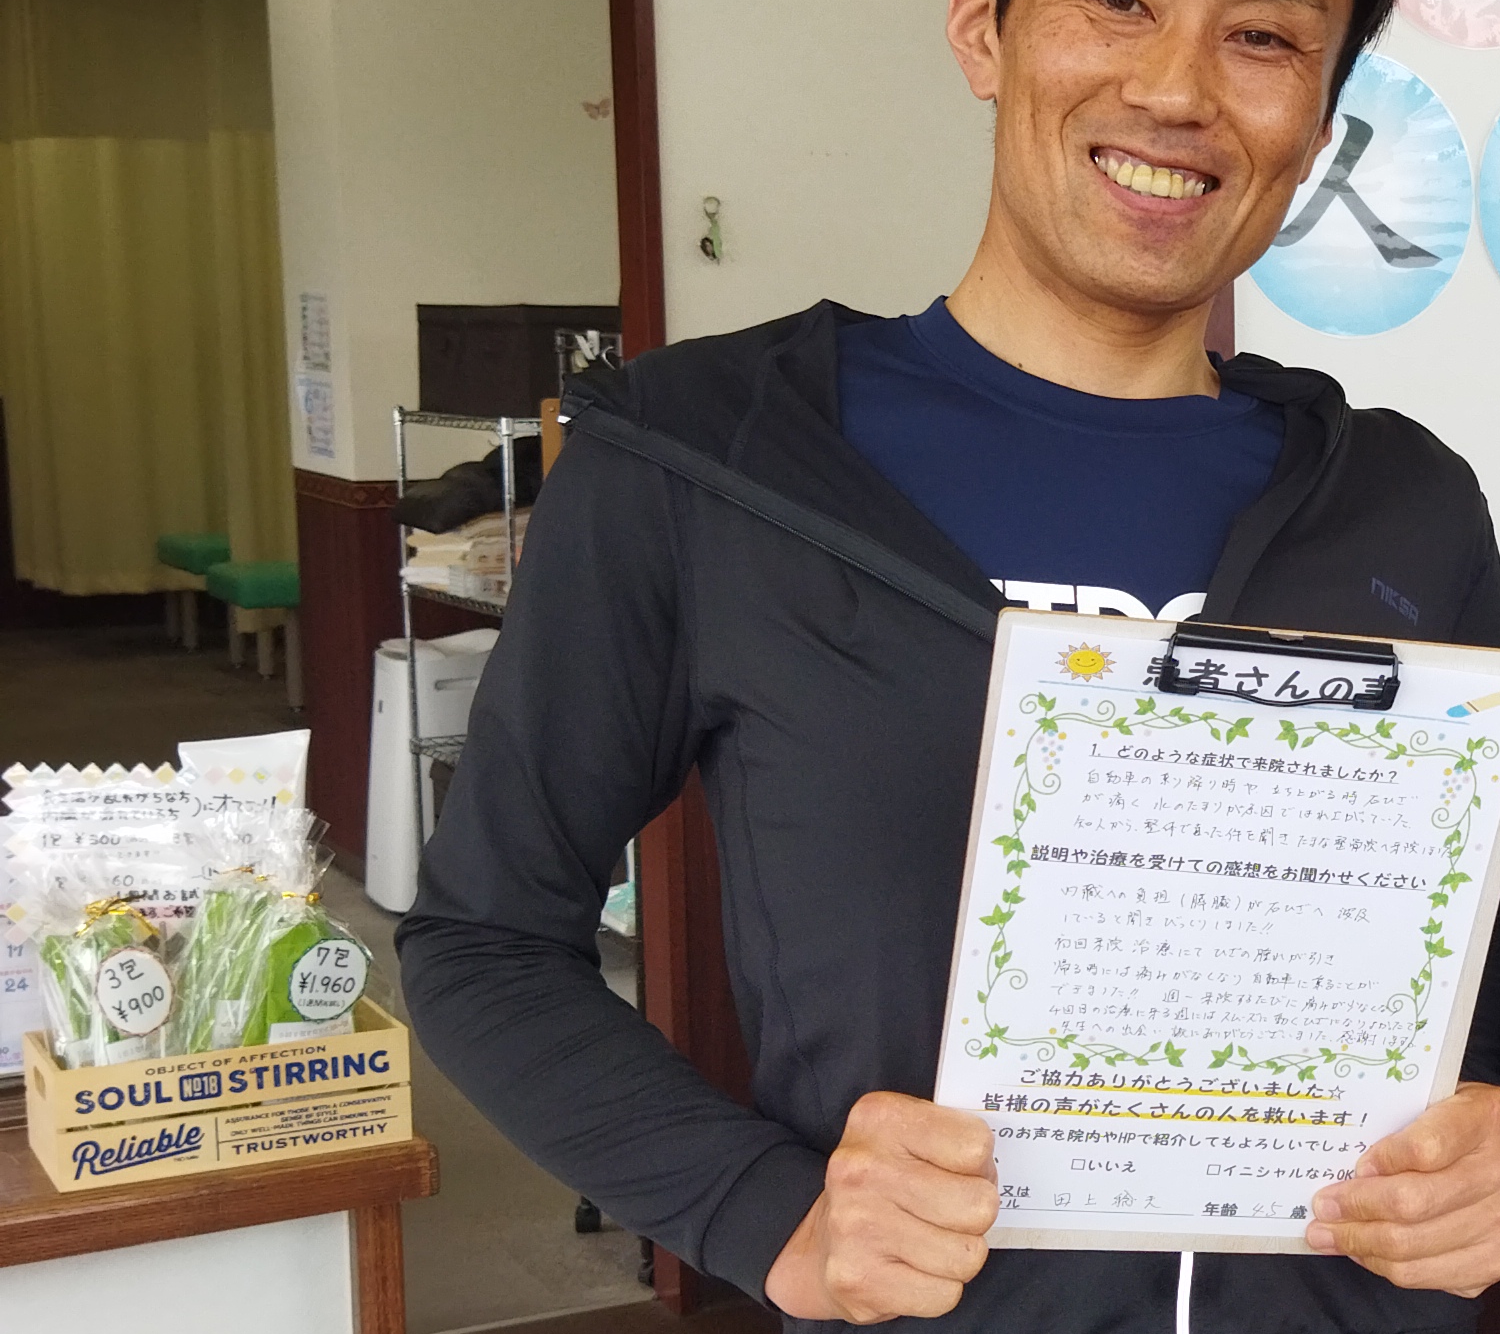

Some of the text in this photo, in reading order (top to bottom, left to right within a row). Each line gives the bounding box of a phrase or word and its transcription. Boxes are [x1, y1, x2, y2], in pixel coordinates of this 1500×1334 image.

[1030, 843, 1428, 889] 説明や治療を受けての感想をお聞かせください
[4, 978, 29, 993] 24
[111, 985, 165, 1023] ¥900
[145, 1044, 327, 1076] OBJECT OF AFFECTION
[74, 1080, 173, 1115] SOUL
[228, 1049, 391, 1094] STIRRING
[231, 1122, 389, 1156] TRUSTWORTHY
[71, 1122, 207, 1181] Reliable
[1222, 1164, 1356, 1181] イニシャルならOK
[1000, 1185, 1031, 1198] 又は
[1202, 1201, 1239, 1217] 年齢
[1252, 1201, 1283, 1218] 45
[1289, 1205, 1308, 1220] 歳
